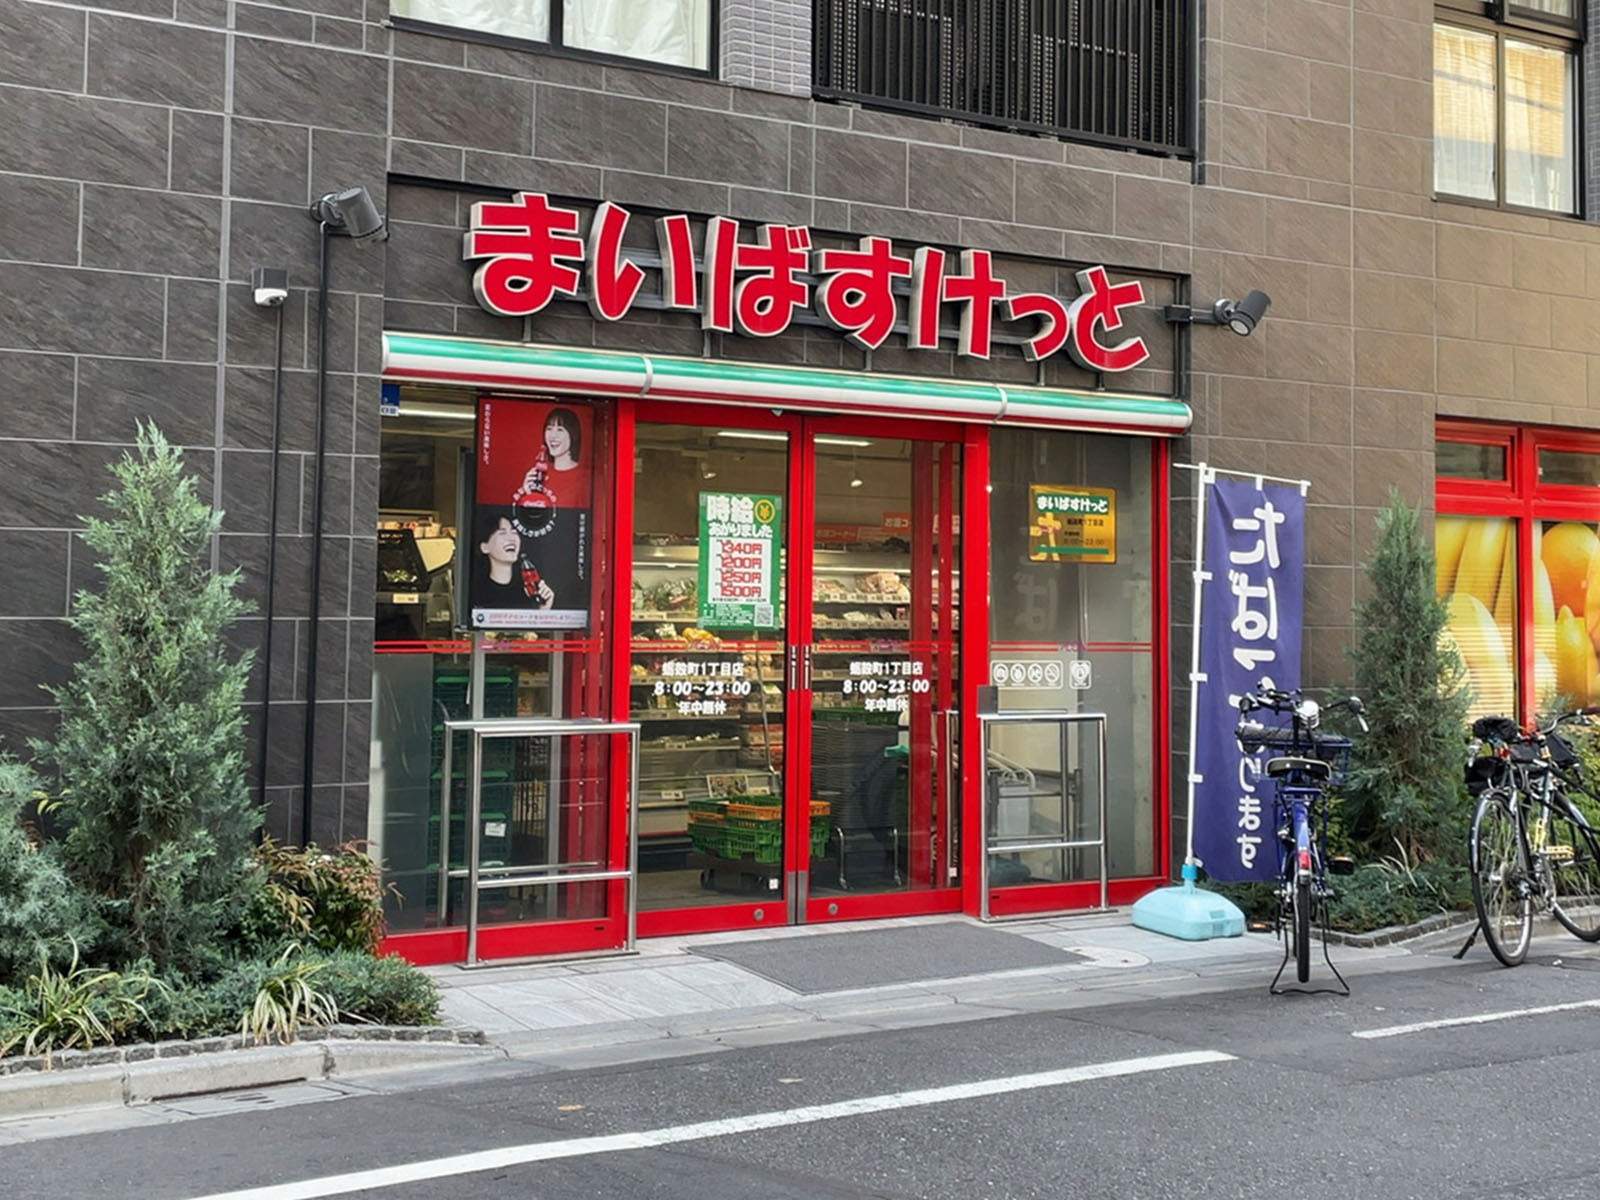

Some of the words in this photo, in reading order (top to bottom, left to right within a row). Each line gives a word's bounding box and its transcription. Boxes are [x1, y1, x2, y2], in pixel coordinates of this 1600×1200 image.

[463, 191, 1150, 372] まいばすけっと
[706, 495, 754, 524] 時給
[1036, 495, 1108, 513] まいばすけっと
[708, 522, 774, 538] あがりました
[721, 540, 762, 555] 1340円
[721, 555, 762, 569] 1200円
[720, 569, 762, 583] 1250円
[720, 583, 761, 597] 1500円
[654, 681, 751, 696] 8:00〜23:00
[843, 679, 929, 694] 8:00〜23:00
[677, 700, 727, 715] 年中無休
[864, 698, 909, 712] 年中無休
